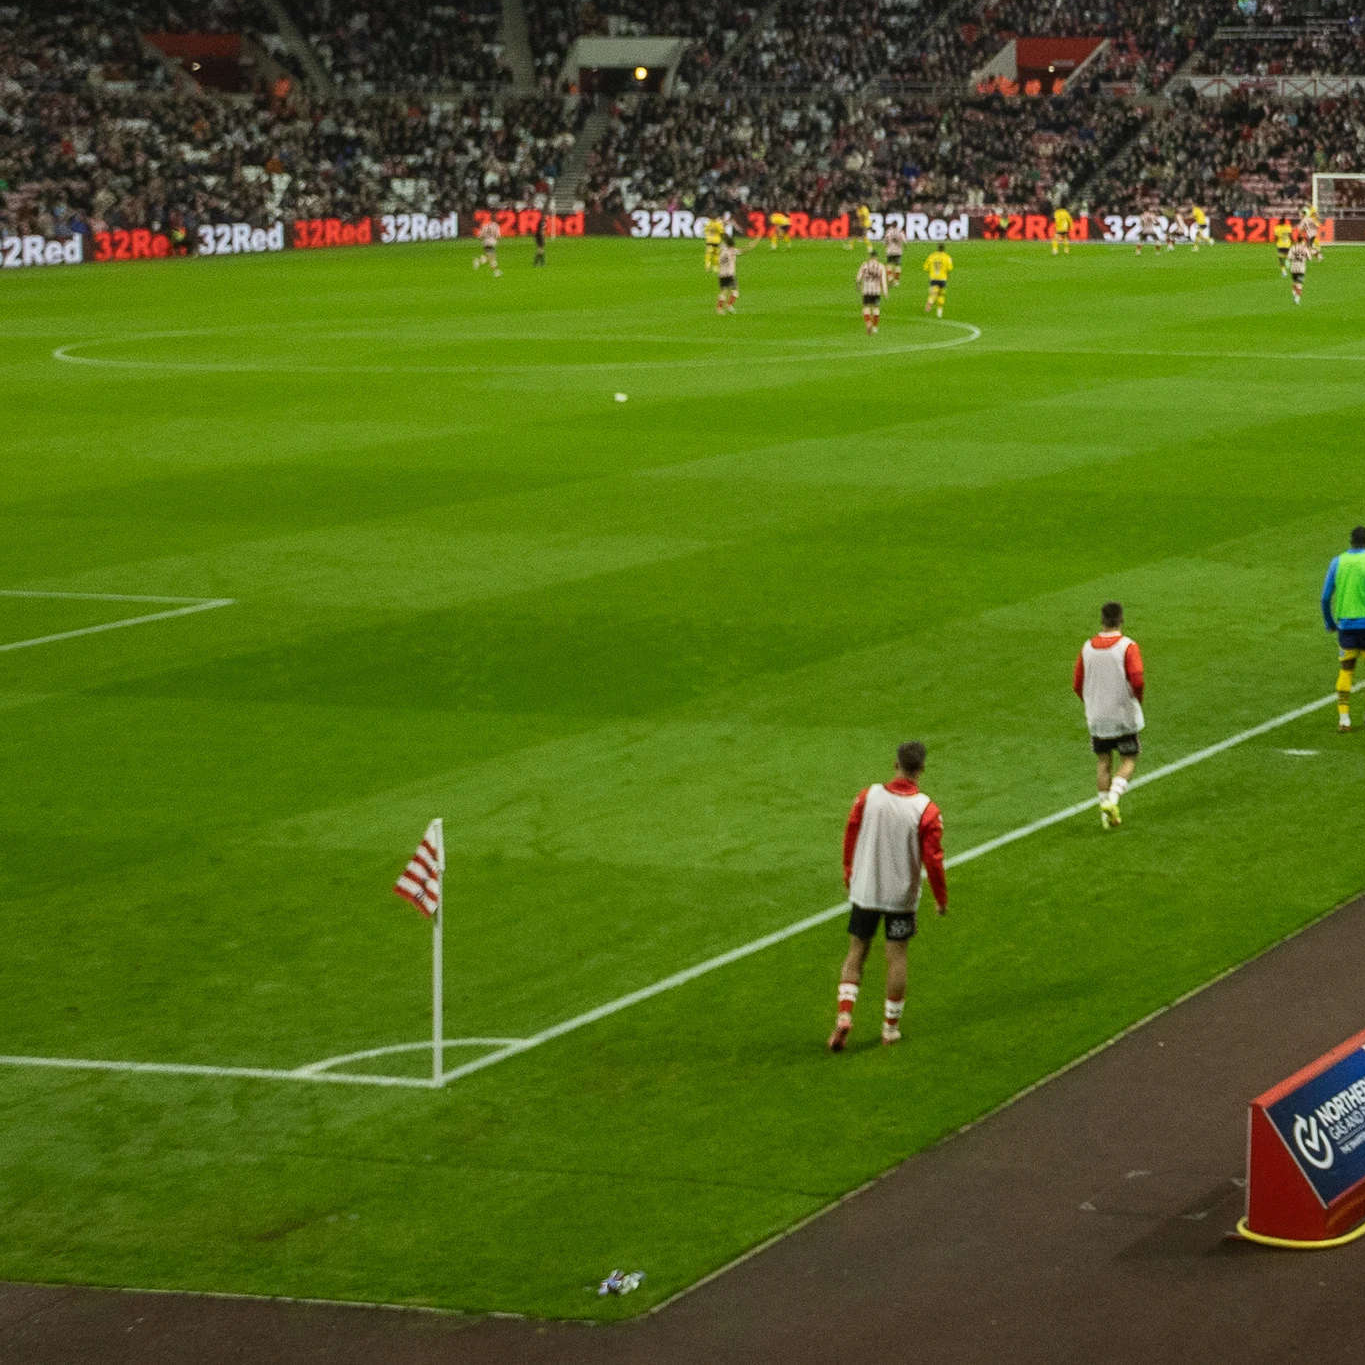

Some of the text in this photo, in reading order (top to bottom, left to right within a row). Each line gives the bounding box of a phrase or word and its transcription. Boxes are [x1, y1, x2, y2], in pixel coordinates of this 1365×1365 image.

[199, 221, 284, 255] 32Red
[293, 216, 373, 249] 32Red
[380, 210, 459, 244] 32Red
[748, 211, 849, 239] 3Red
[0, 232, 83, 268] 2Red
[94, 228, 187, 262] 32Re
[1328, 1119, 1349, 1141] GAS
[1343, 1108, 1365, 1131] AND
